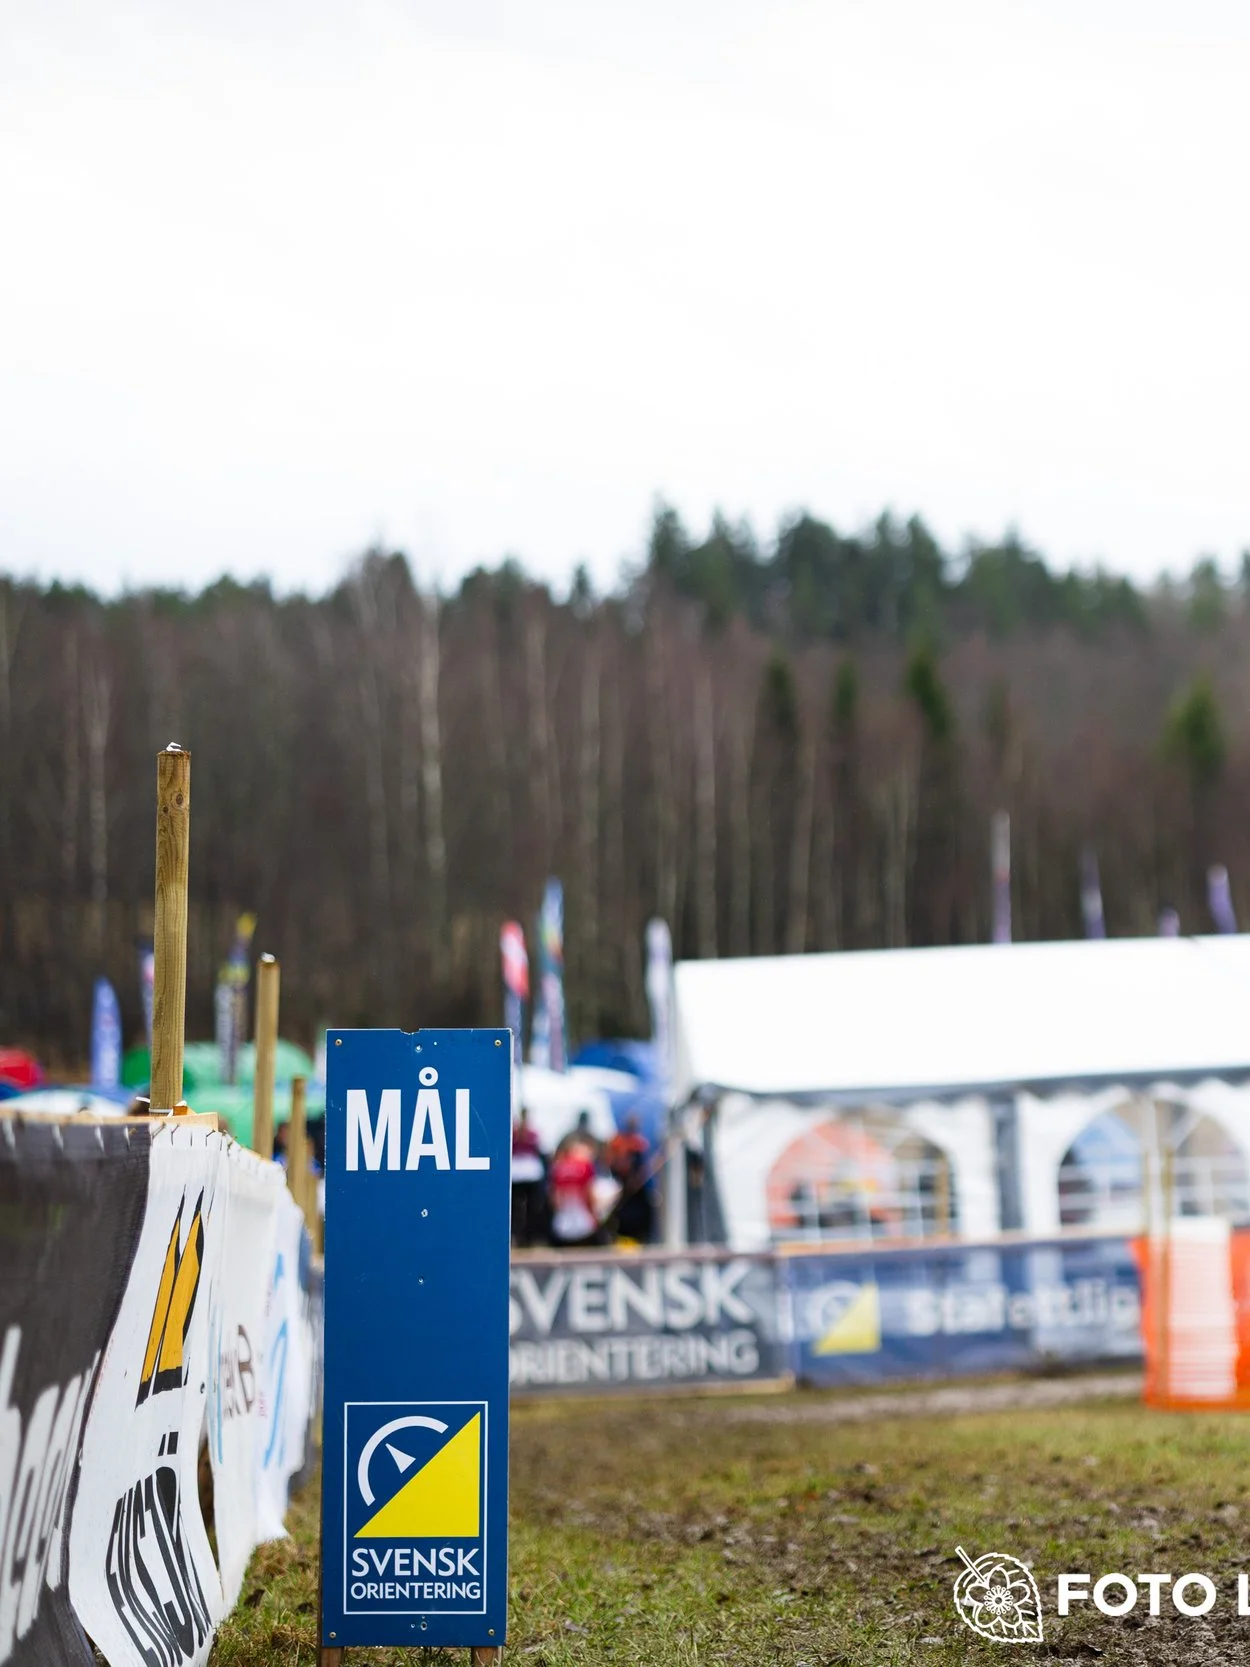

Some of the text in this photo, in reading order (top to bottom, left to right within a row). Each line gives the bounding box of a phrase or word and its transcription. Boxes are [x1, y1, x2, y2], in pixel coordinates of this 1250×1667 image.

[345, 1066, 490, 1171] MÅL
[352, 1547, 480, 1577] SVENSK
[351, 1582, 481, 1600] ORIENTERING
